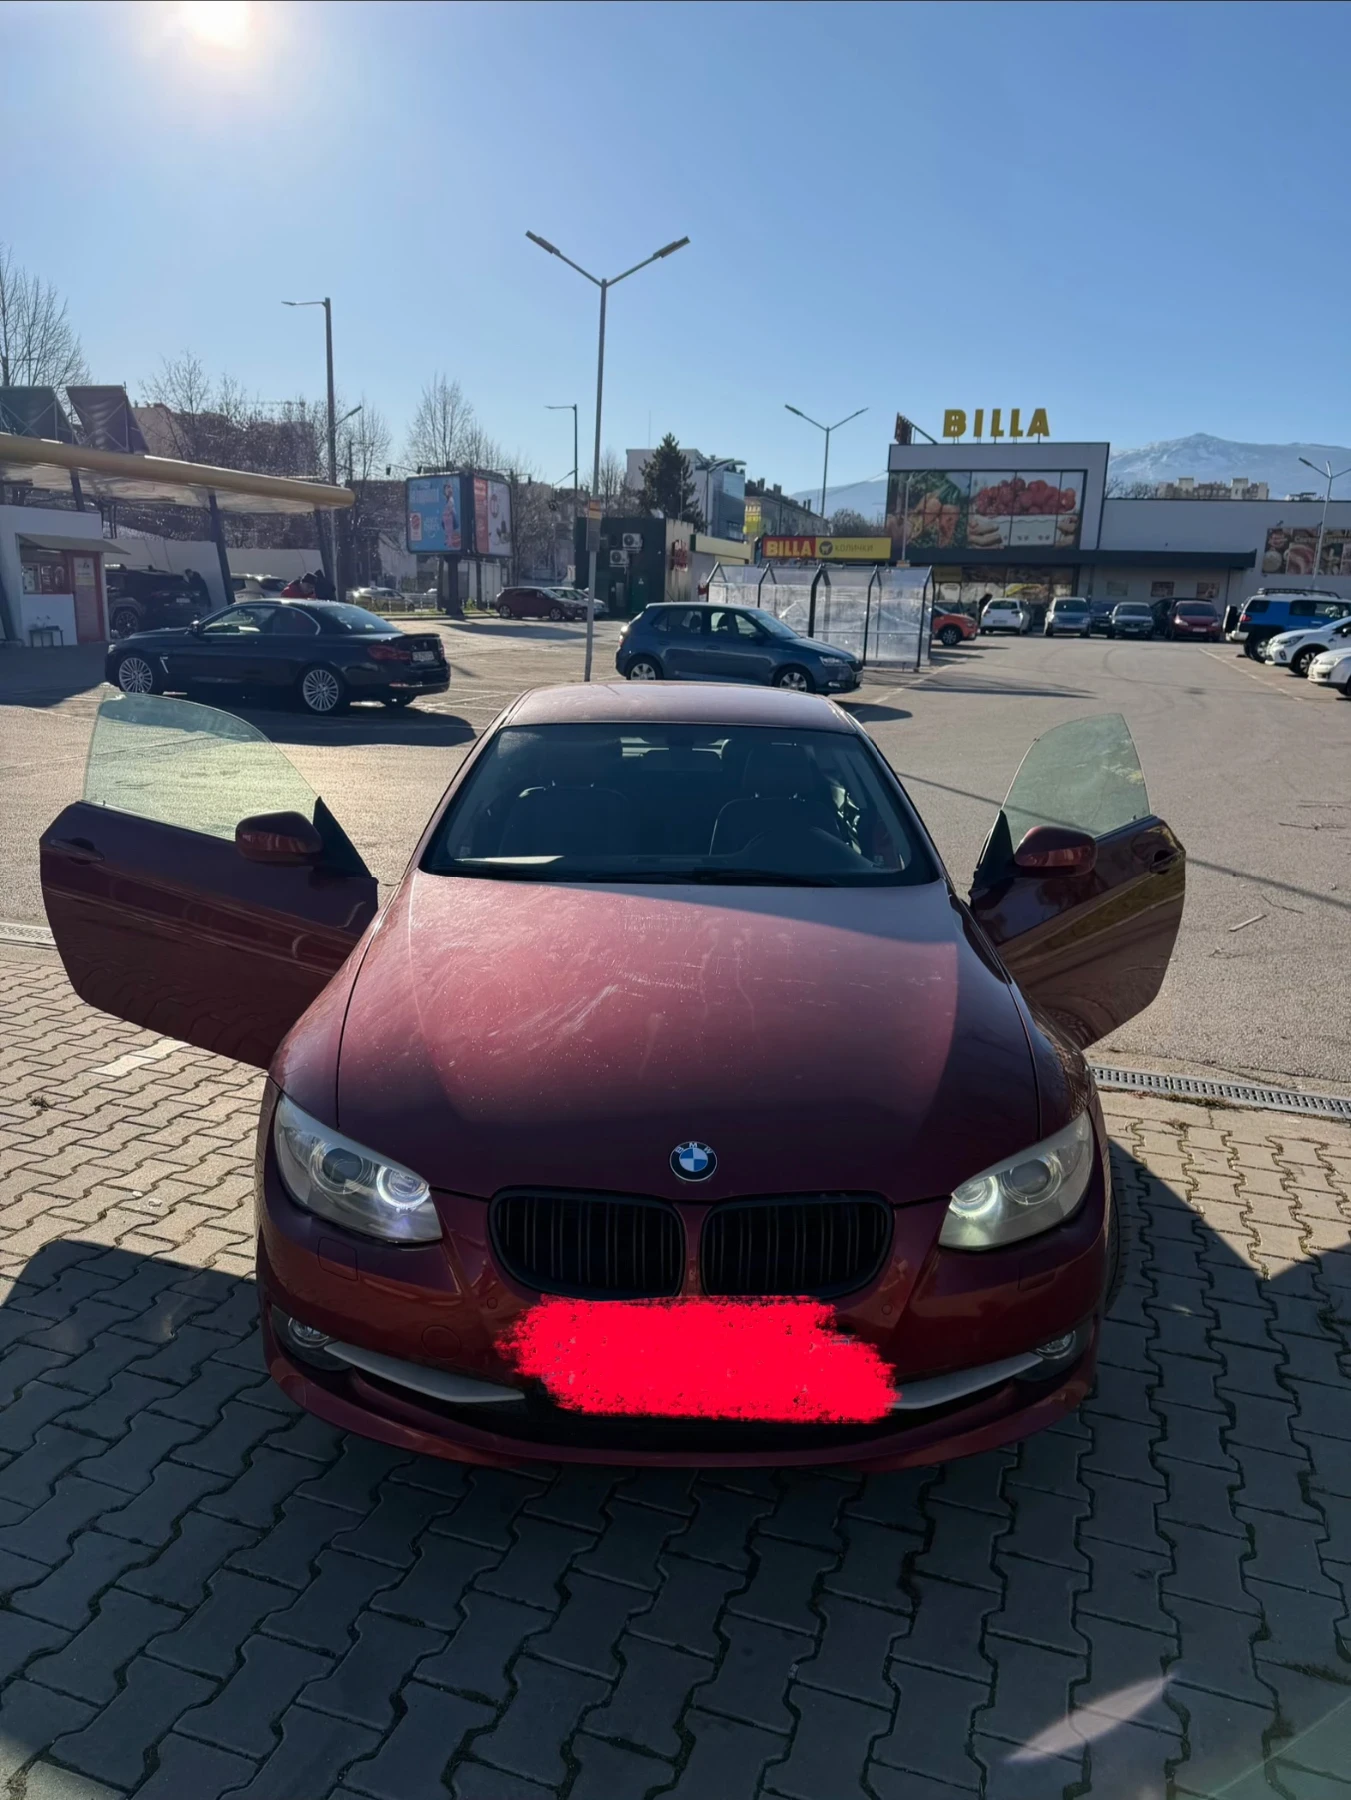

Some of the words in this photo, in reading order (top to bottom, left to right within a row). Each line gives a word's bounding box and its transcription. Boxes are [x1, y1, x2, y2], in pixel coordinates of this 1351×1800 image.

[943, 408, 1050, 437] BILLA
[766, 541, 812, 556] BILLA
[675, 1142, 713, 1154] BMW
